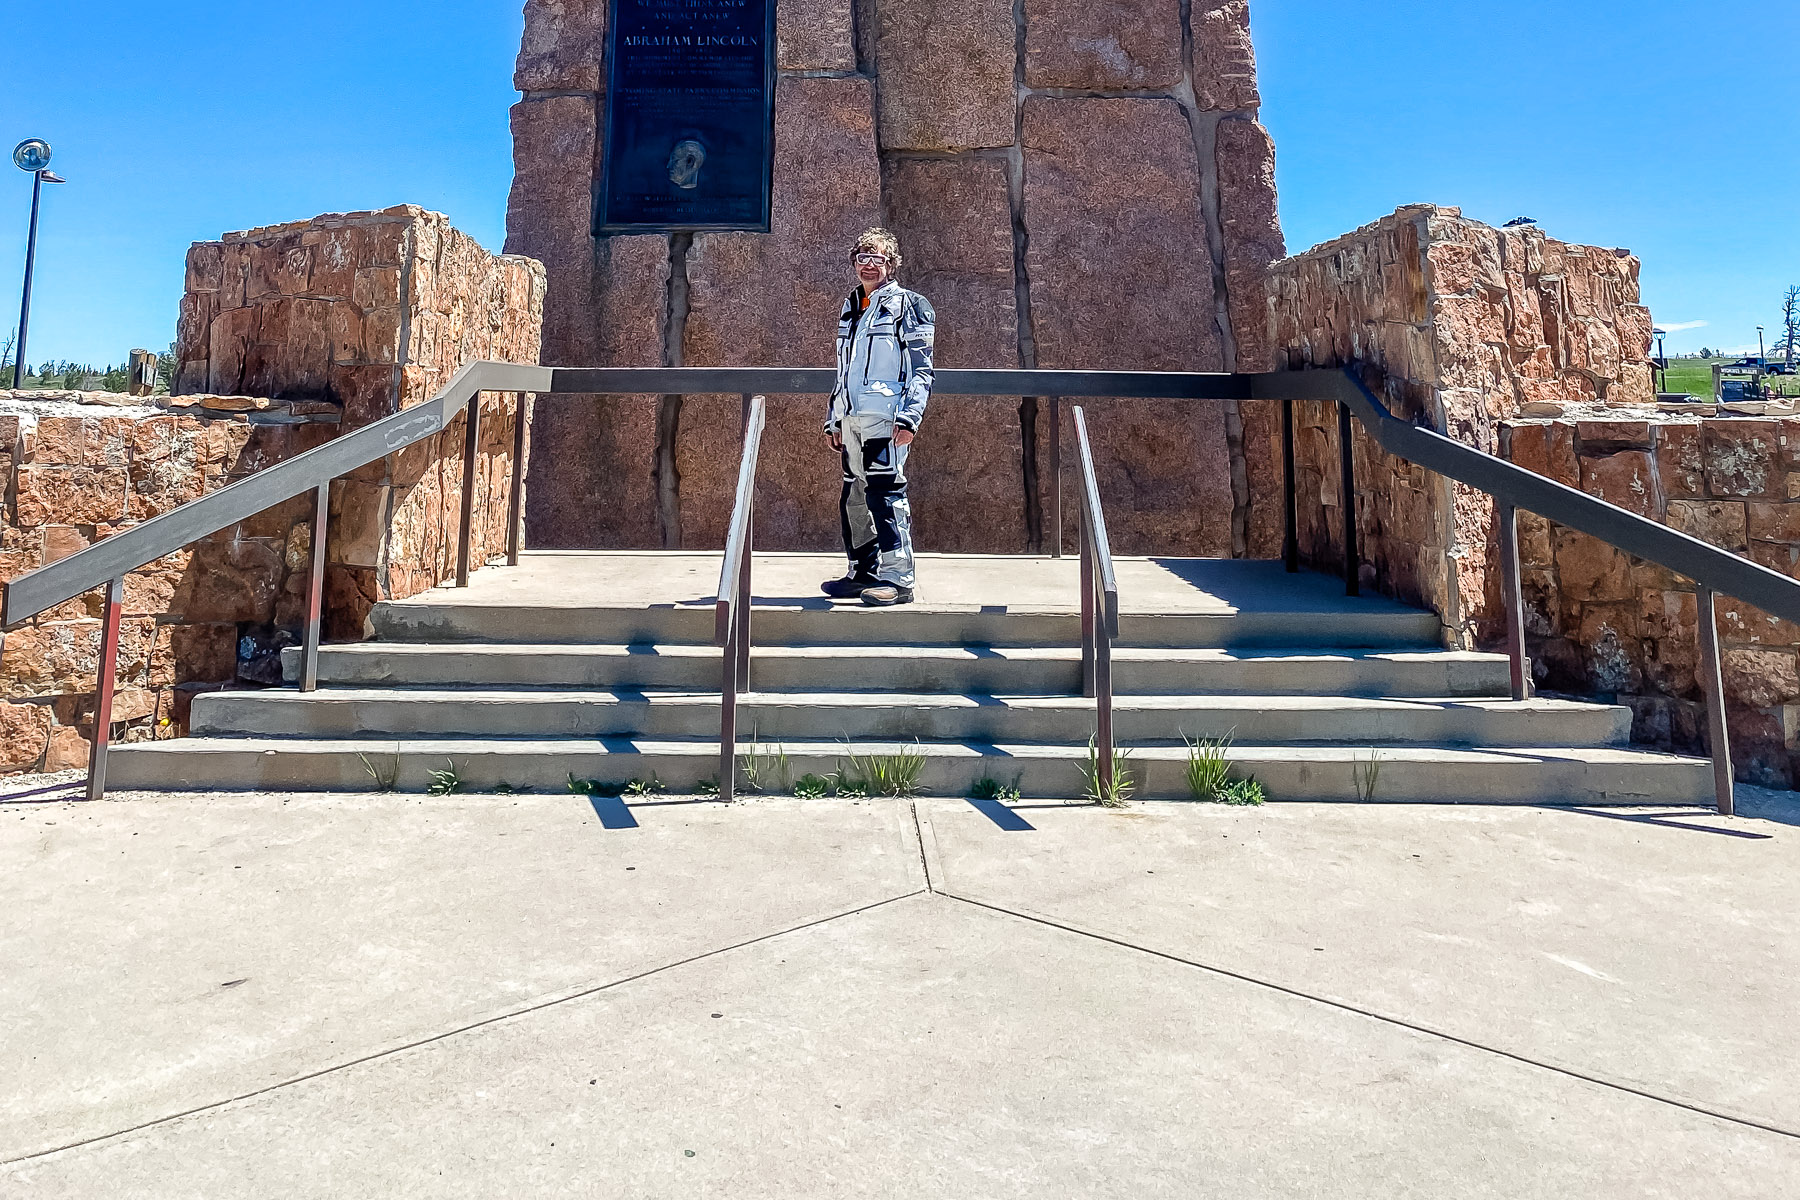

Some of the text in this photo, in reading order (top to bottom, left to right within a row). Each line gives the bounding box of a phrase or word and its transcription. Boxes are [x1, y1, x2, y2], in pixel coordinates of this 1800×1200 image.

[637, 0, 651, 8] WE
[685, 0, 714, 8] THINK
[718, 0, 747, 8] ANEW
[680, 11, 698, 21] ACT
[702, 11, 730, 21] ANEW
[623, 35, 759, 46] ABRAHAM LINCOLN
